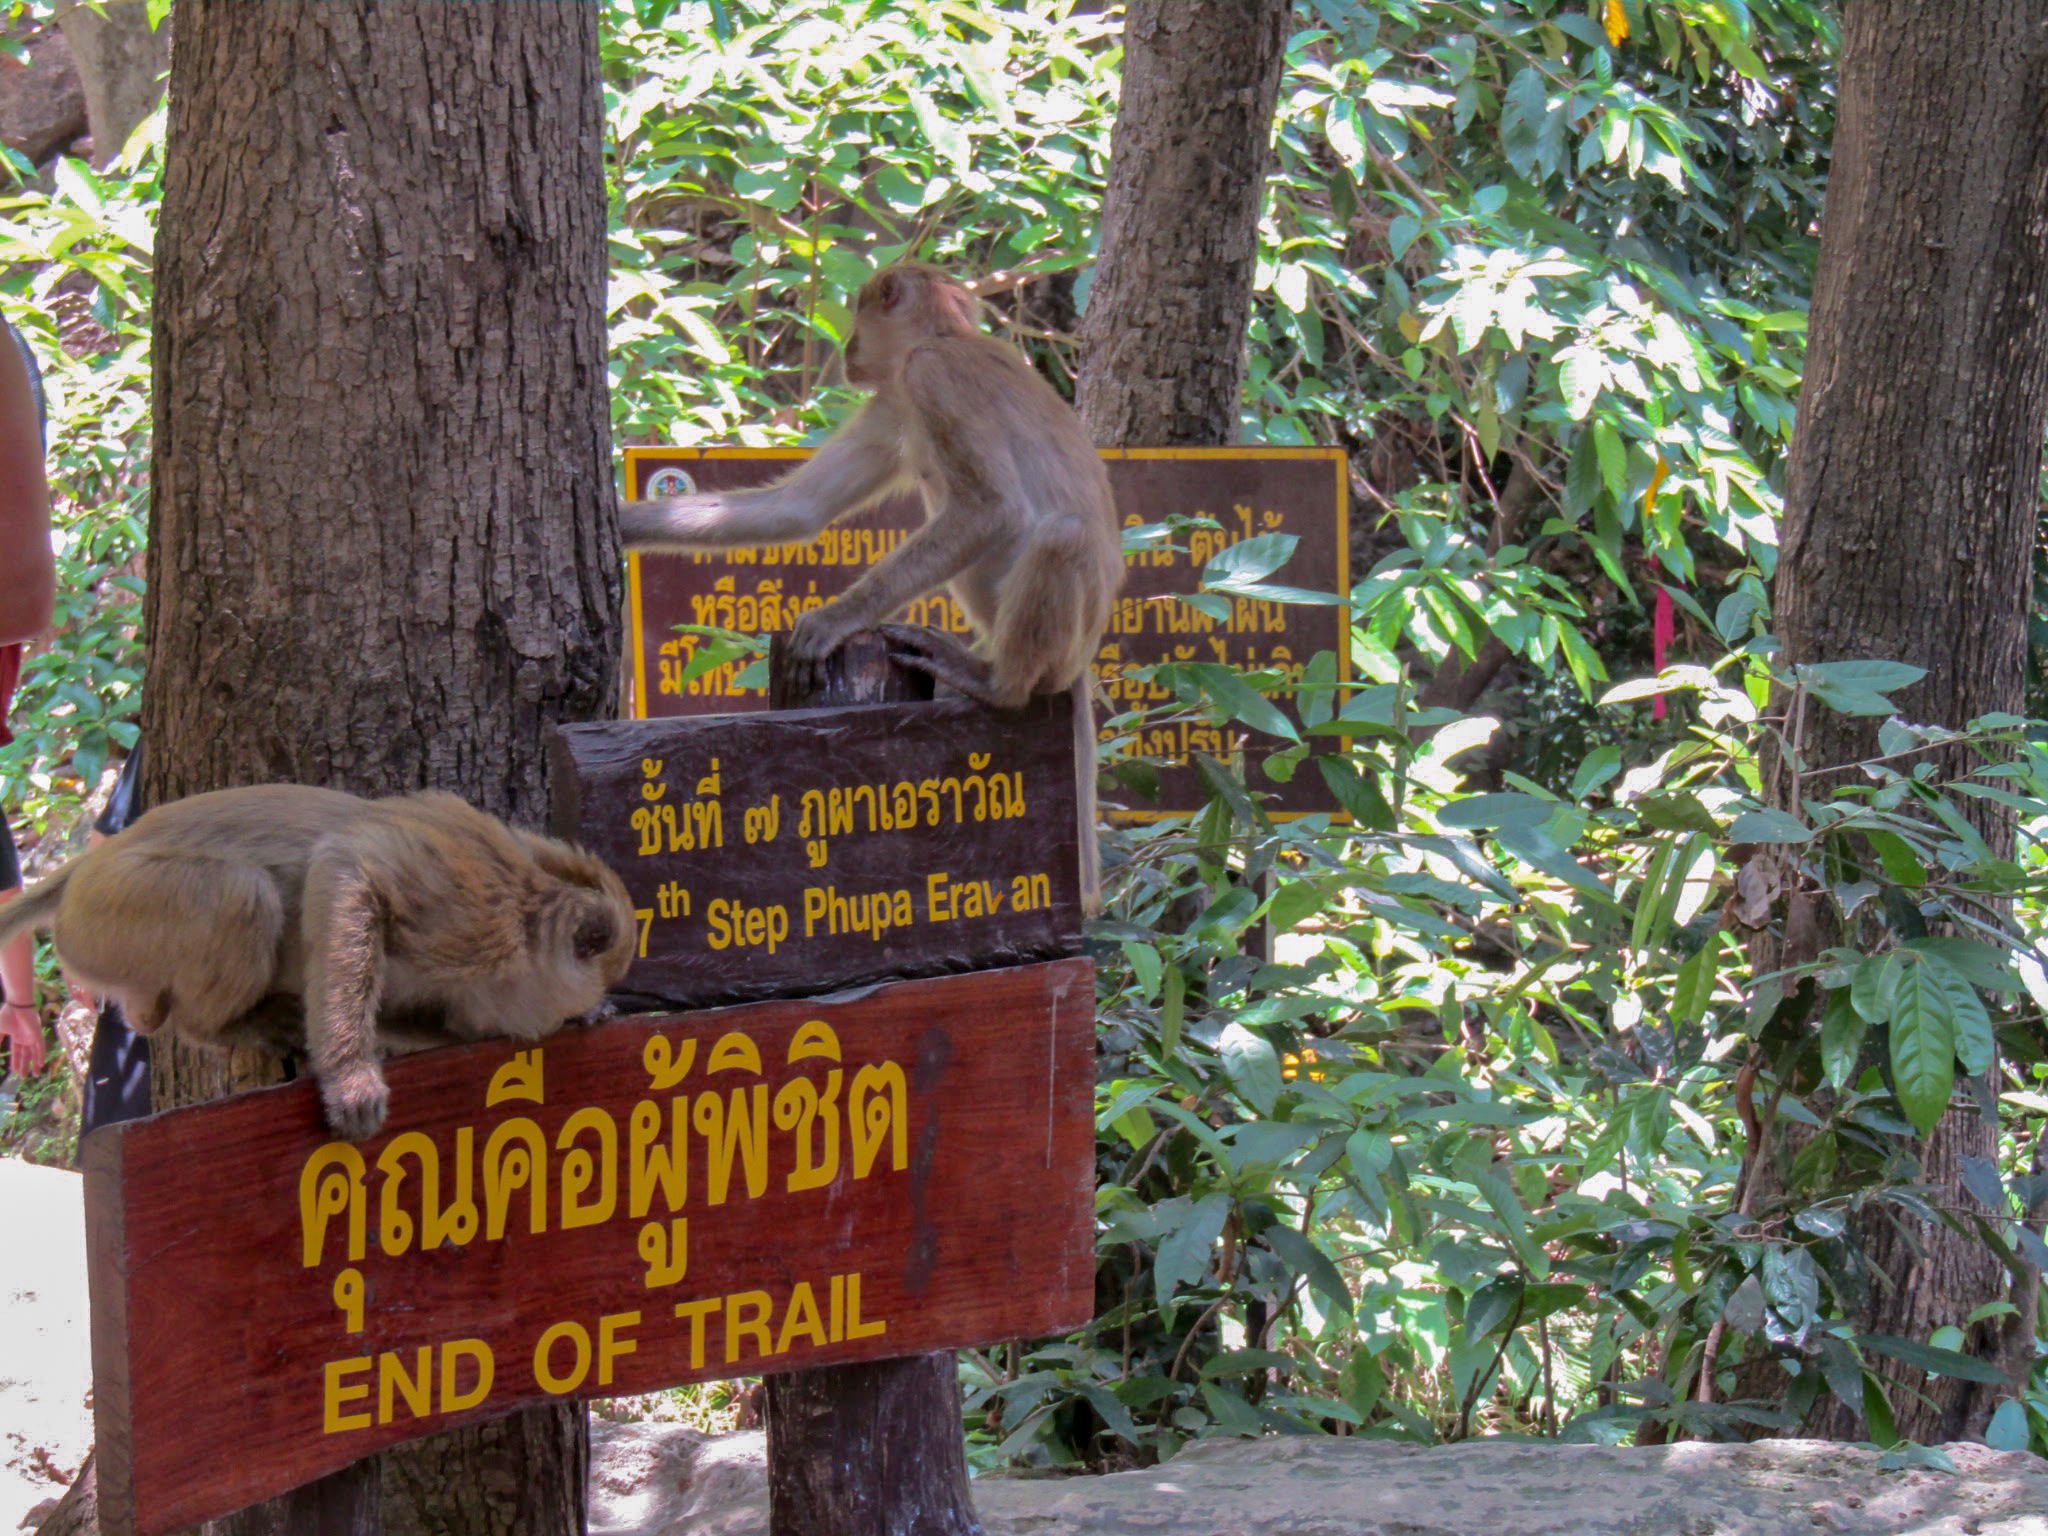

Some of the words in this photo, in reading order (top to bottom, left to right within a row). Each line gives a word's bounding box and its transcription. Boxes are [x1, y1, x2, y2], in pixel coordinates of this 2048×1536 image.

[631, 758, 723, 856] ชั้นที่
[744, 794, 780, 844] ๗
[798, 752, 1026, 867] ภูผาเอราวัณ
[633, 880, 691, 958] 7th
[707, 898, 788, 954] Step
[804, 885, 912, 941] Phupa
[300, 1020, 908, 1332] คุณคือผู้พิชิต
[324, 1338, 495, 1434] END
[533, 1311, 640, 1394] OF
[675, 1273, 886, 1369] TRAIL
